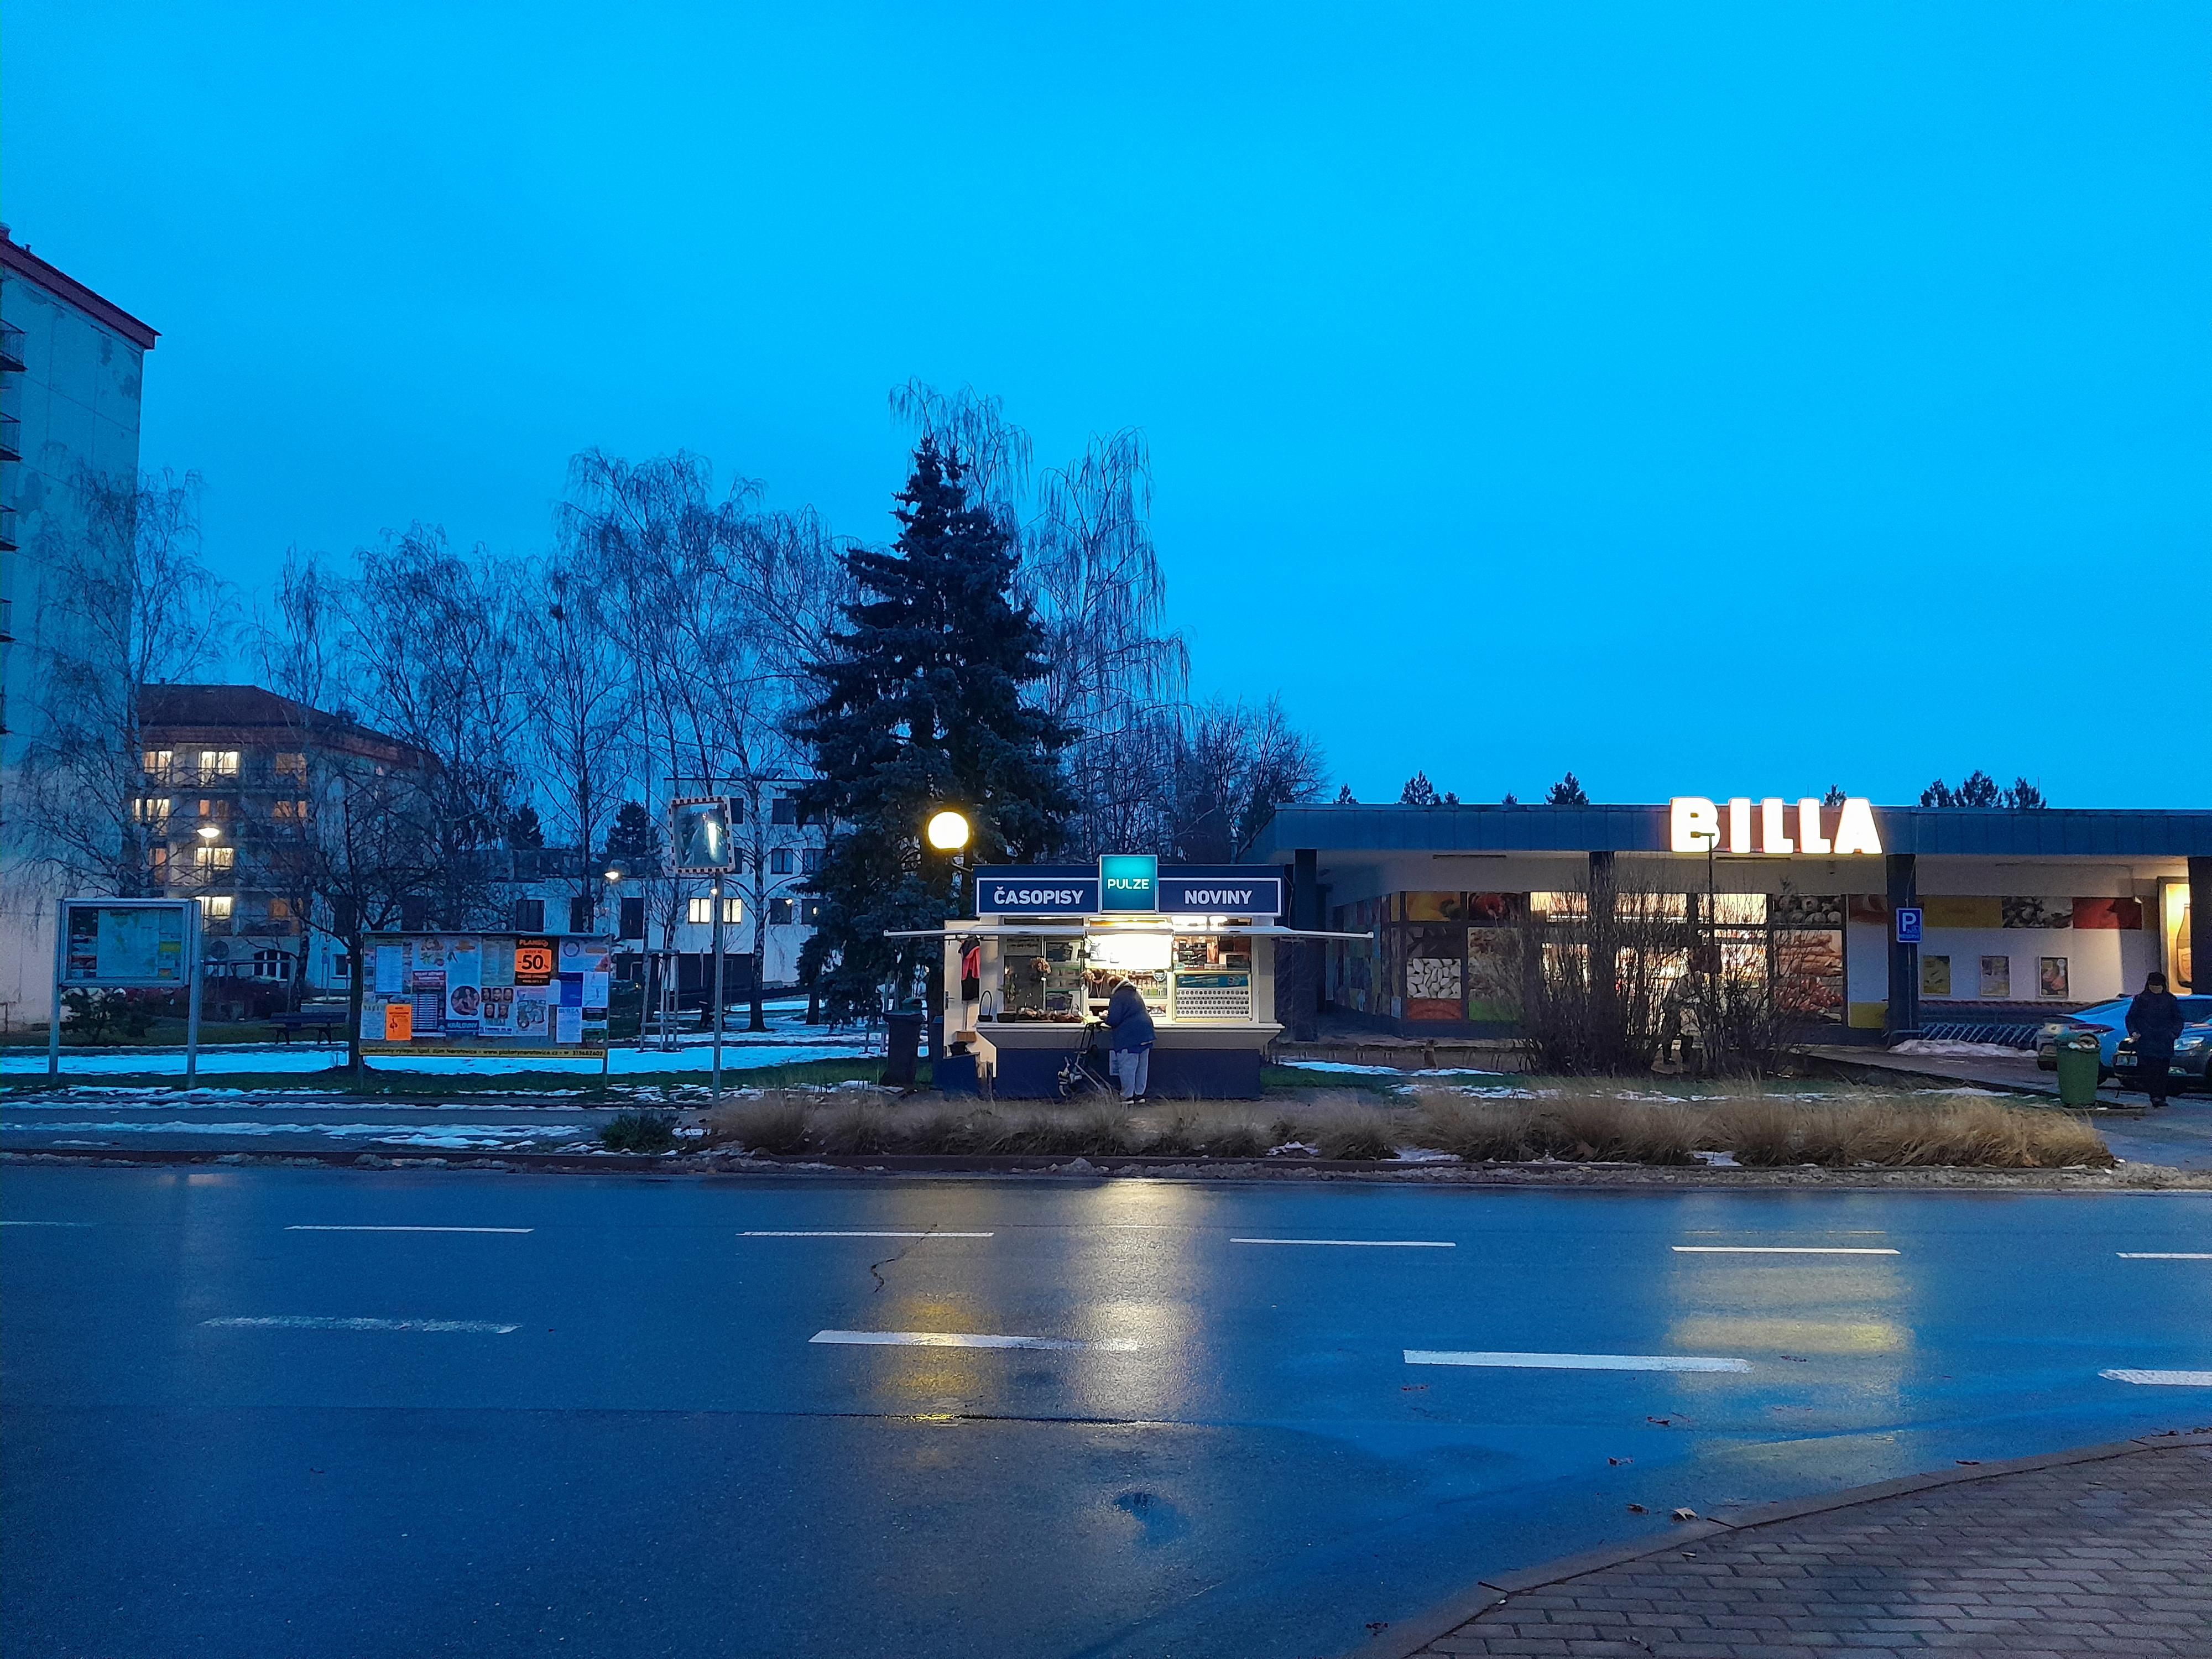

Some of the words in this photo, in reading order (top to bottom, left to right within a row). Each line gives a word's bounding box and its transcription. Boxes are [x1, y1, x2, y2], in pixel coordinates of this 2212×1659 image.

[1671, 797, 1882, 854] BILLA
[1108, 878, 1150, 890] PULZE
[994, 886, 1084, 905] ČASOPISY
[1185, 890, 1253, 905] NOVINY
[1902, 912, 1917, 932] P
